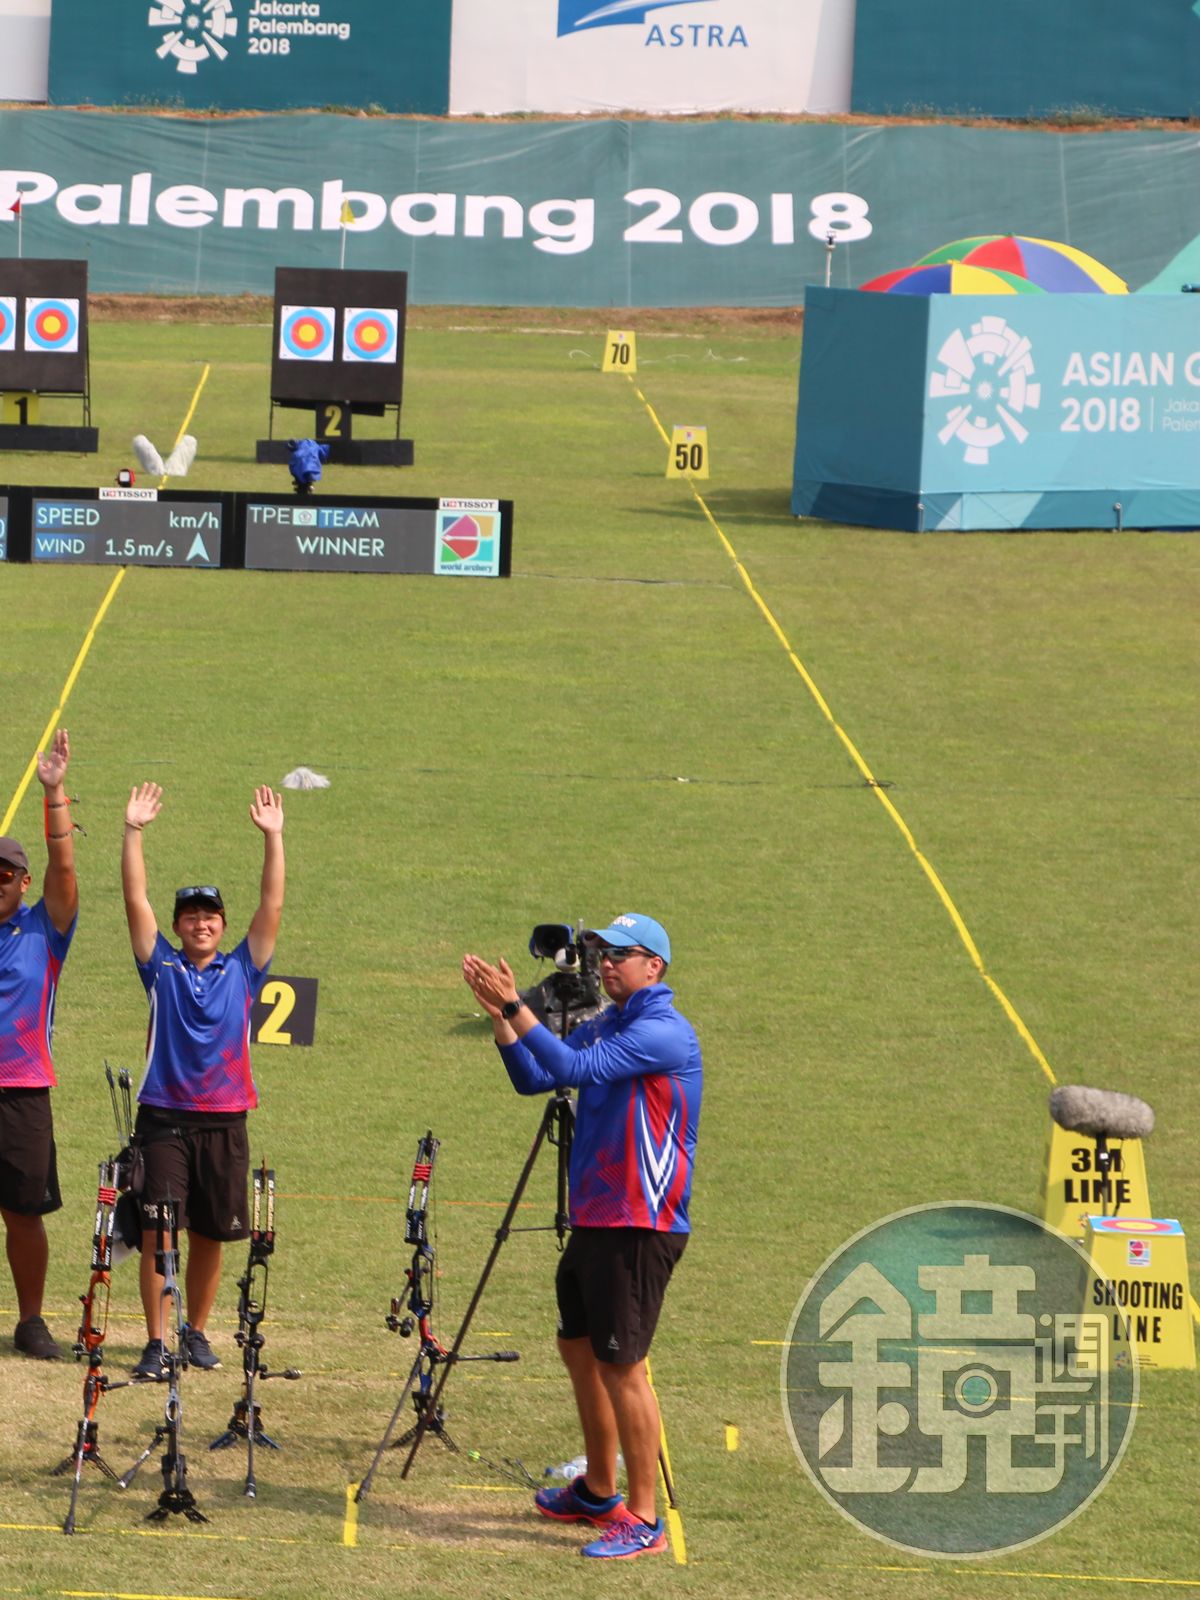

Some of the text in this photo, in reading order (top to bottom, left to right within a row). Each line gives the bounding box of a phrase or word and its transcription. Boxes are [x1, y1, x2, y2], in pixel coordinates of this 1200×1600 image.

[249, 1, 320, 17] Jakarta
[248, 18, 350, 40] Palembang
[645, 24, 749, 48] ASTRA
[247, 38, 291, 54] 2018
[624, 188, 873, 245] 2018
[611, 343, 630, 364] 70
[1061, 352, 1175, 386] ASIAN
[14, 396, 28, 425] 1
[325, 405, 341, 436] 2
[1060, 397, 1141, 432] 2018
[675, 443, 703, 471] 50
[117, 490, 154, 498] TISSOT
[456, 501, 495, 509] TISSOT
[37, 507, 219, 529] SPEED km/h
[250, 507, 380, 528] TPE TEAM
[36, 538, 85, 554] WIND
[296, 536, 385, 557] WINNER
[257, 981, 297, 1046] 2
[1064, 1178, 1131, 1203] LINE
[1093, 1279, 1183, 1310] SHOOTING
[1113, 1314, 1162, 1343] LINE
